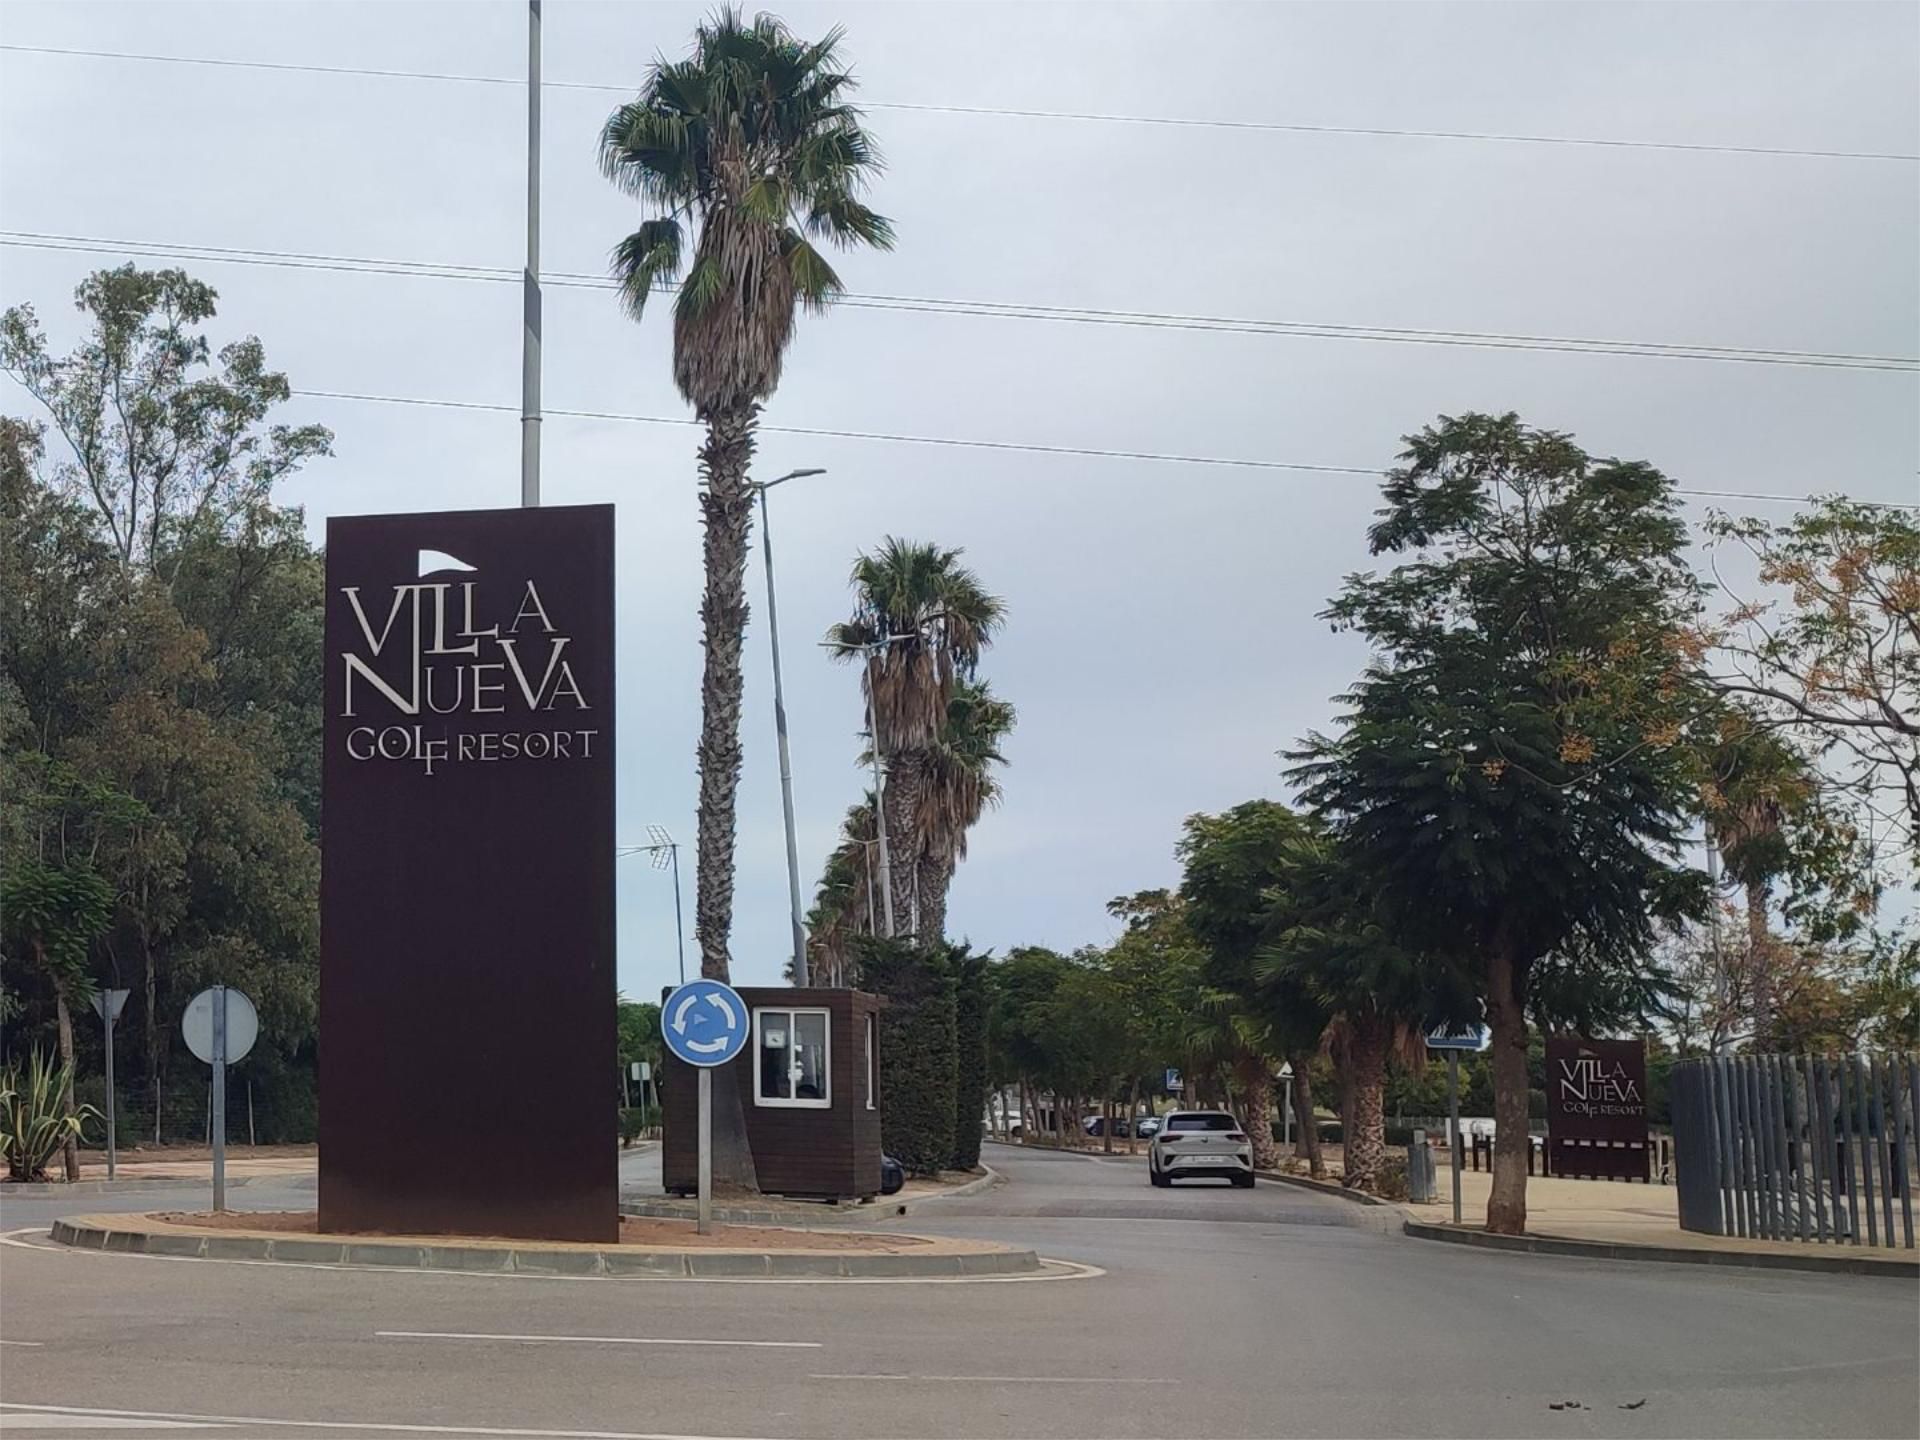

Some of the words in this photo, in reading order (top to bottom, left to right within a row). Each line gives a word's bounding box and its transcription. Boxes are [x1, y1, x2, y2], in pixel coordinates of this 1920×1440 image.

[339, 579, 559, 658] VILLA
[339, 637, 593, 717] NUEVA
[346, 725, 449, 776] GOLF
[457, 730, 599, 761] RESORT
[1559, 1059, 1627, 1083] VILLA
[1560, 1079, 1641, 1102] NUEVA
[1600, 1105, 1645, 1116] RESORT
